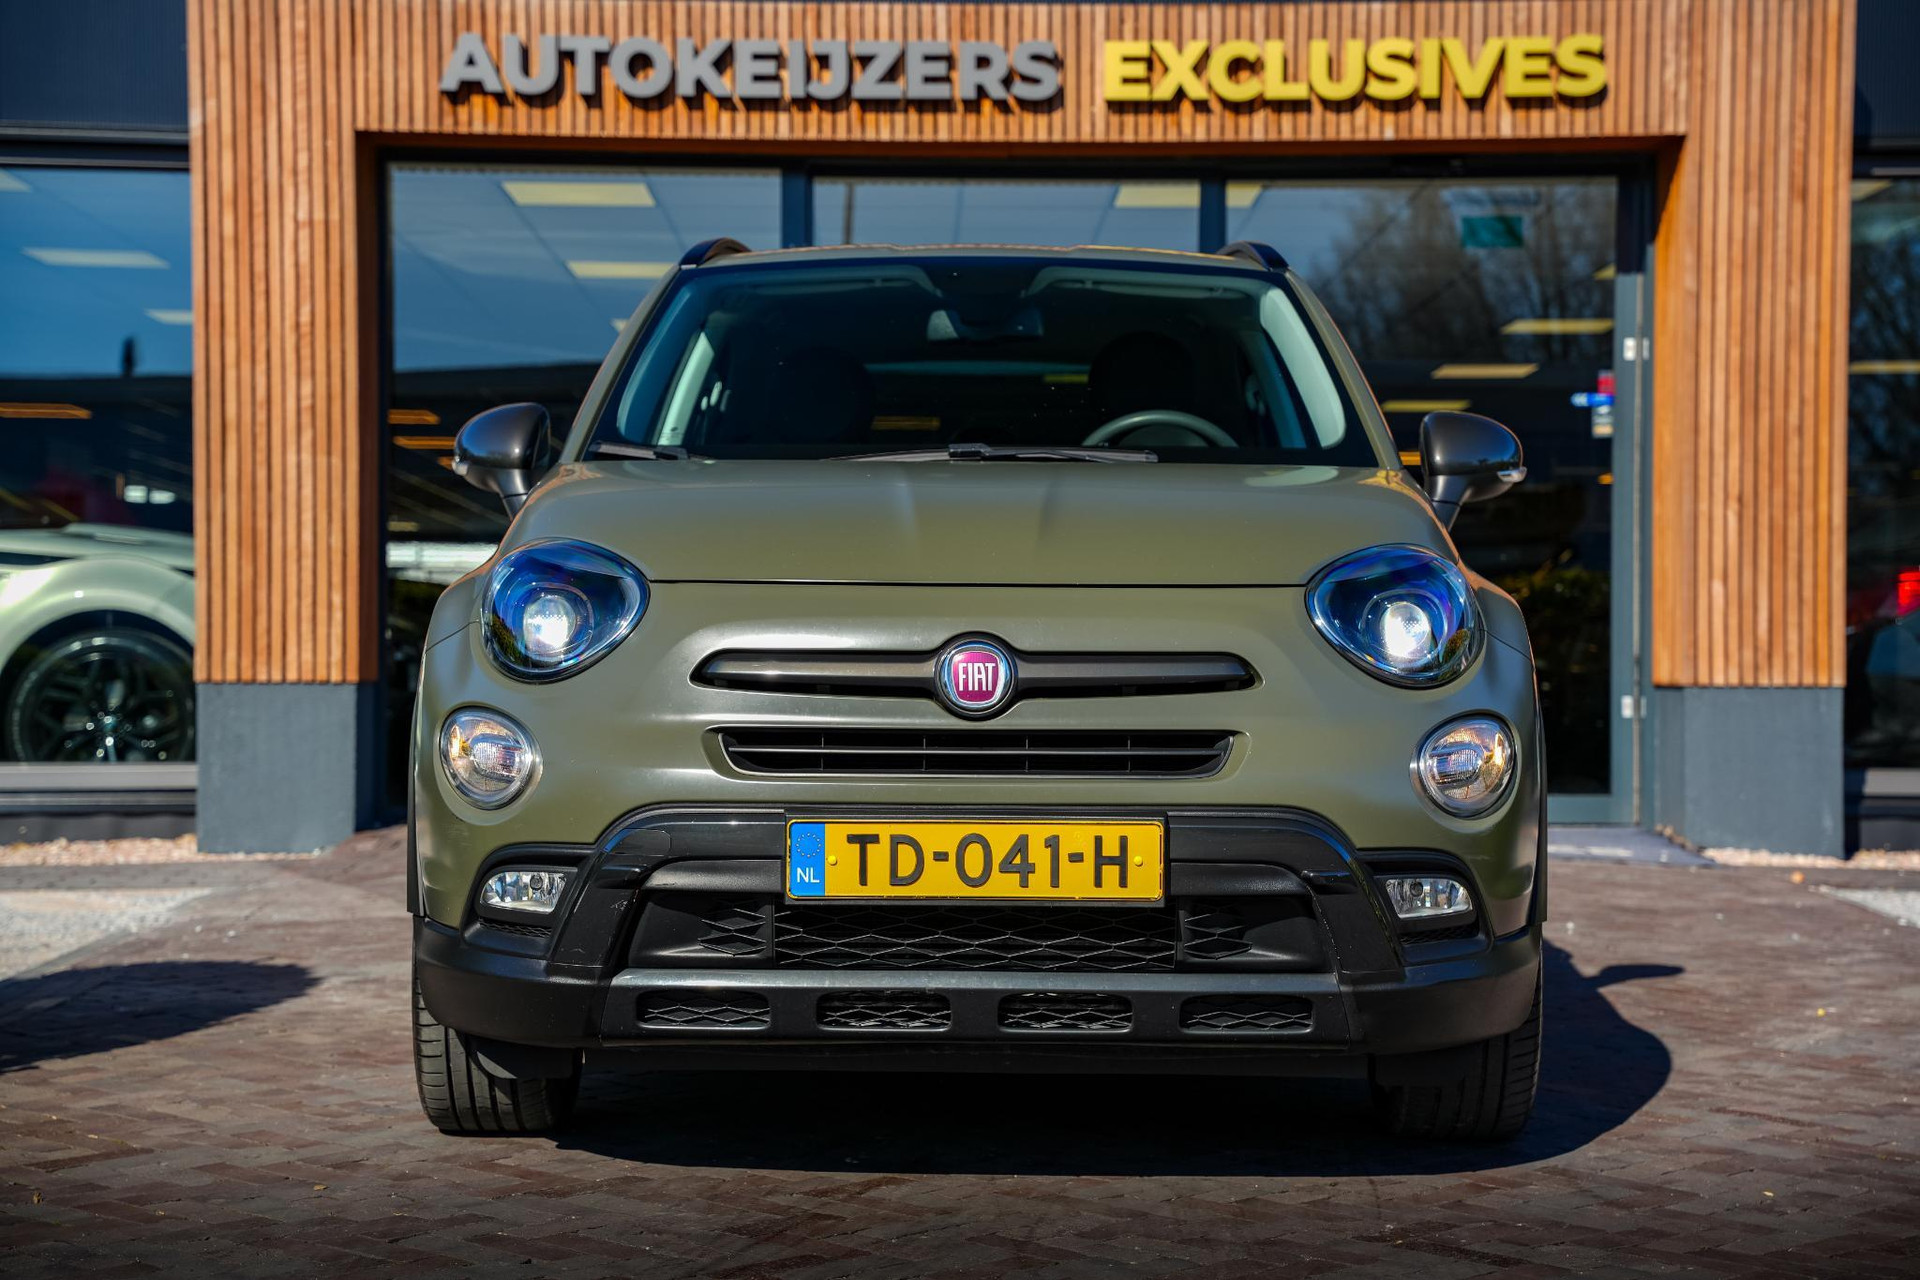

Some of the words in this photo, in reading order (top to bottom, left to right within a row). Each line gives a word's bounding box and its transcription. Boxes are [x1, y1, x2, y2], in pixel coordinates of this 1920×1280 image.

[440, 31, 1061, 102] AUTOKEIJZERS
[1104, 33, 1608, 103] EXCLUSIVES
[958, 662, 996, 692] FIAT
[796, 867, 820, 883] NL
[846, 832, 1128, 888] TD-041-H
